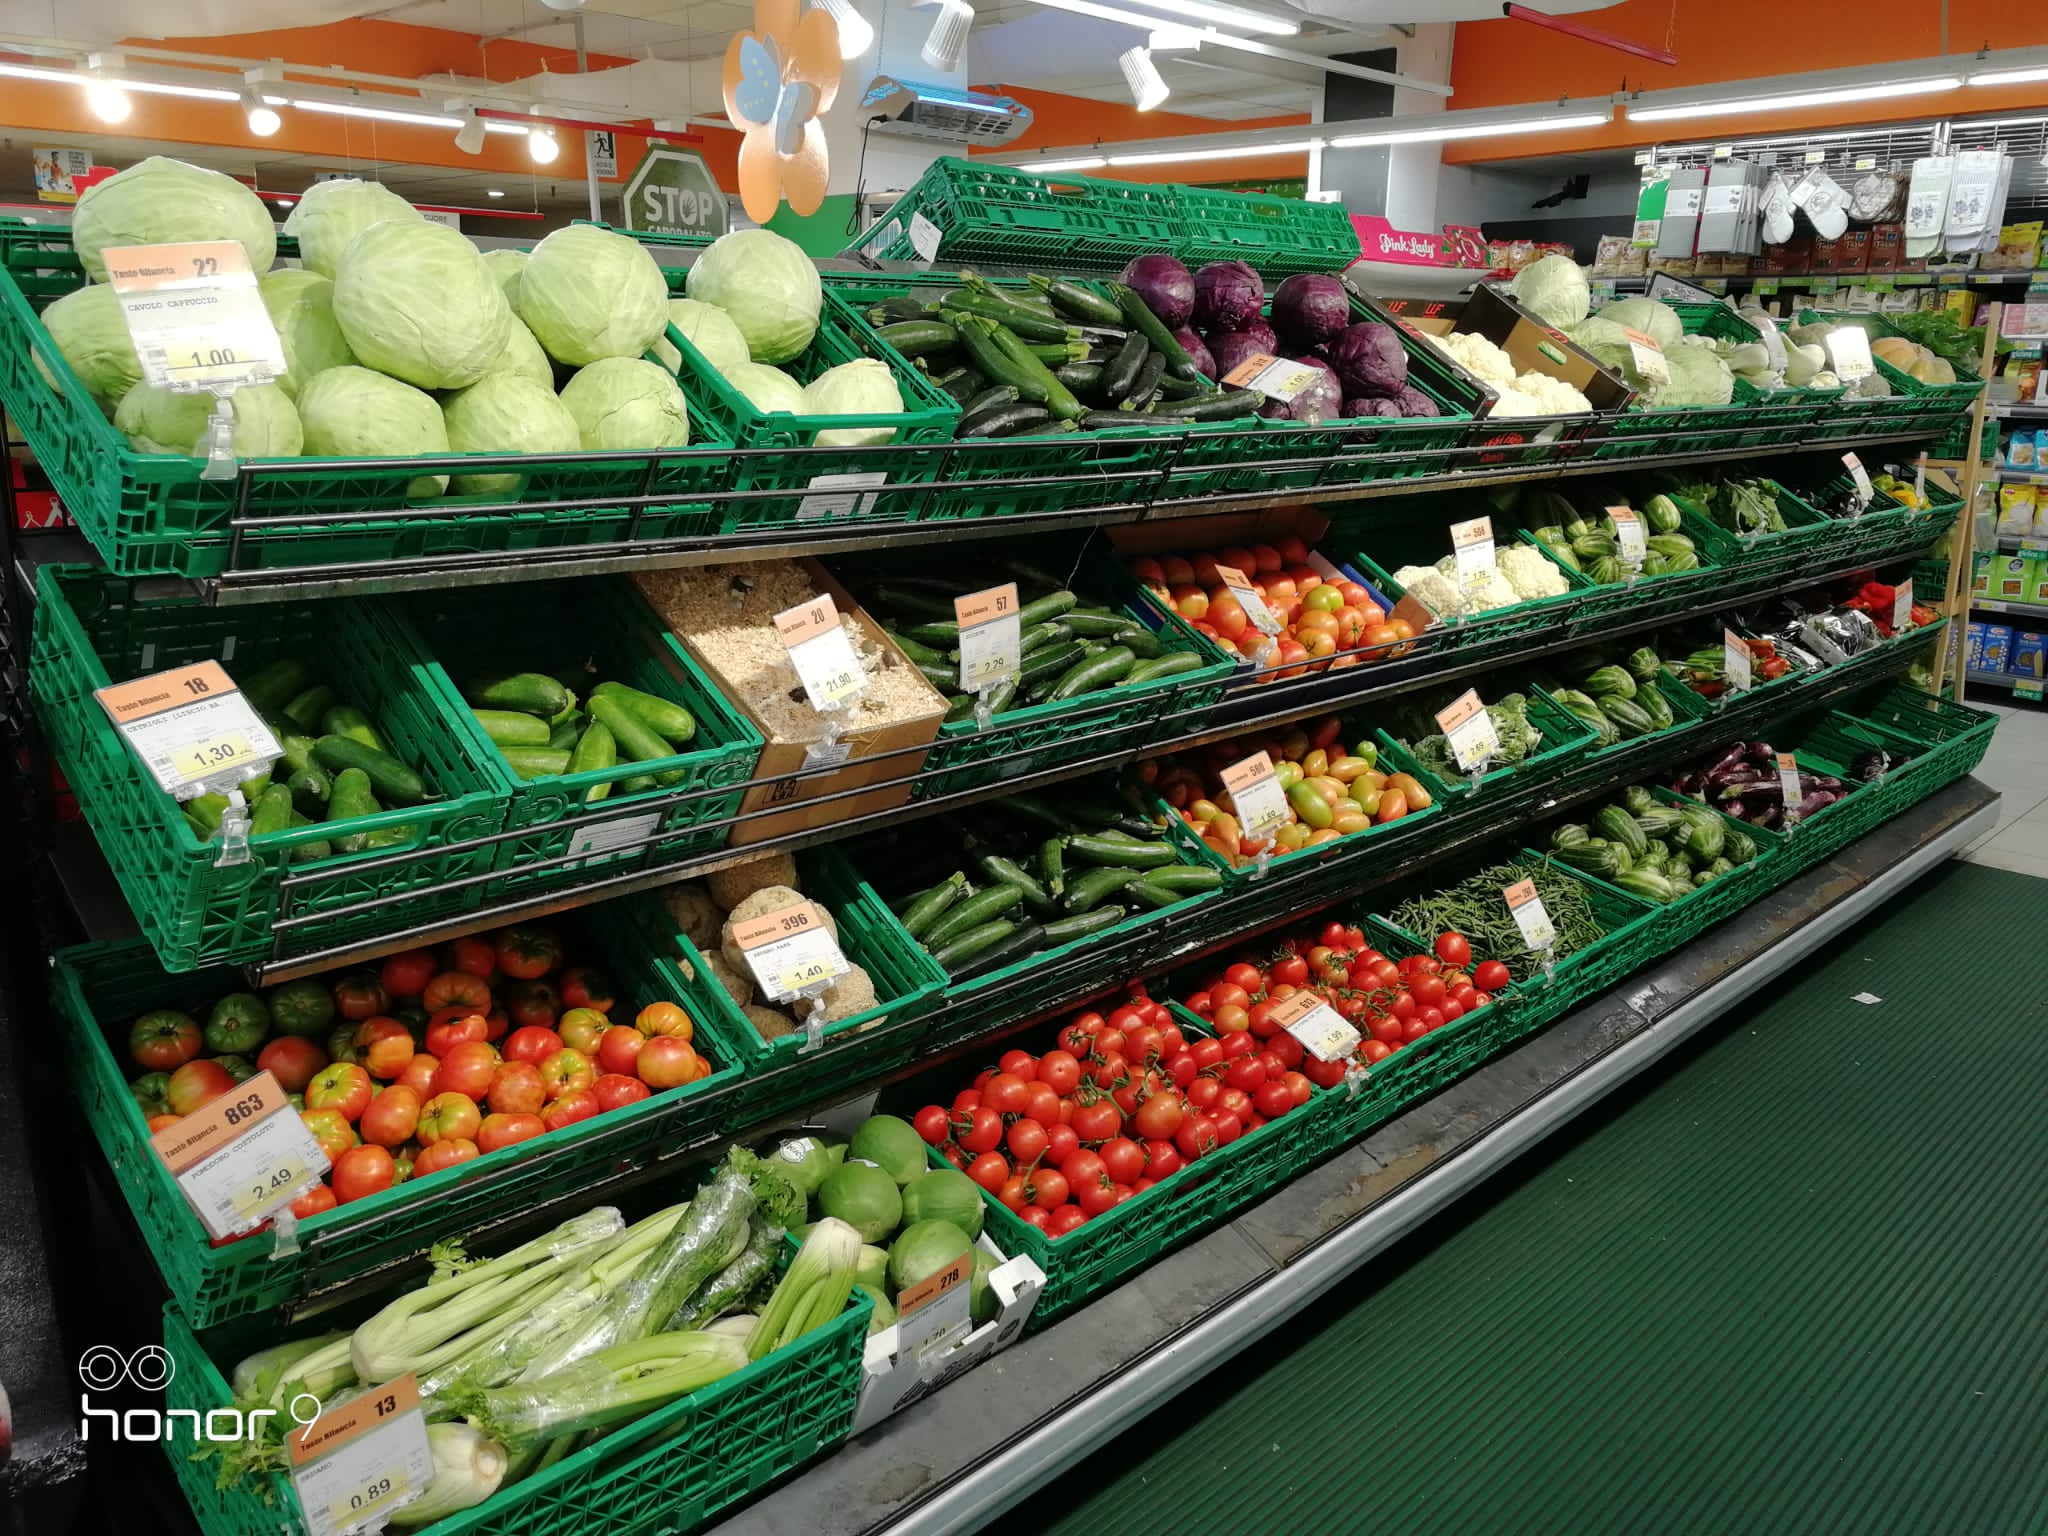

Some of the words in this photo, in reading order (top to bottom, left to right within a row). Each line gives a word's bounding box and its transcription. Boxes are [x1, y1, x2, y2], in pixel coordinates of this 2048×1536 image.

[643, 184, 713, 226] STOP
[1379, 233, 1409, 254] Pink
[1409, 236, 1434, 258] Lady
[192, 256, 219, 278] 22
[128, 301, 163, 312] CAVOLO
[167, 296, 218, 308] CAPPUCCIO
[996, 595, 1007, 611] 57
[810, 607, 825, 624] 20
[183, 677, 210, 696] 18
[193, 742, 235, 767] 1,30
[781, 912, 808, 931] 396
[794, 964, 823, 981] 1,40
[224, 1092, 265, 1126] 863
[165, 1143, 187, 1159] Tasto
[187, 1123, 218, 1147] Bilancia
[939, 1267, 960, 1291] 278
[374, 1395, 397, 1417] 13
[300, 1437, 323, 1453] Tasto
[324, 1418, 357, 1441] Bilancia
[350, 1478, 391, 1510] 0,89
